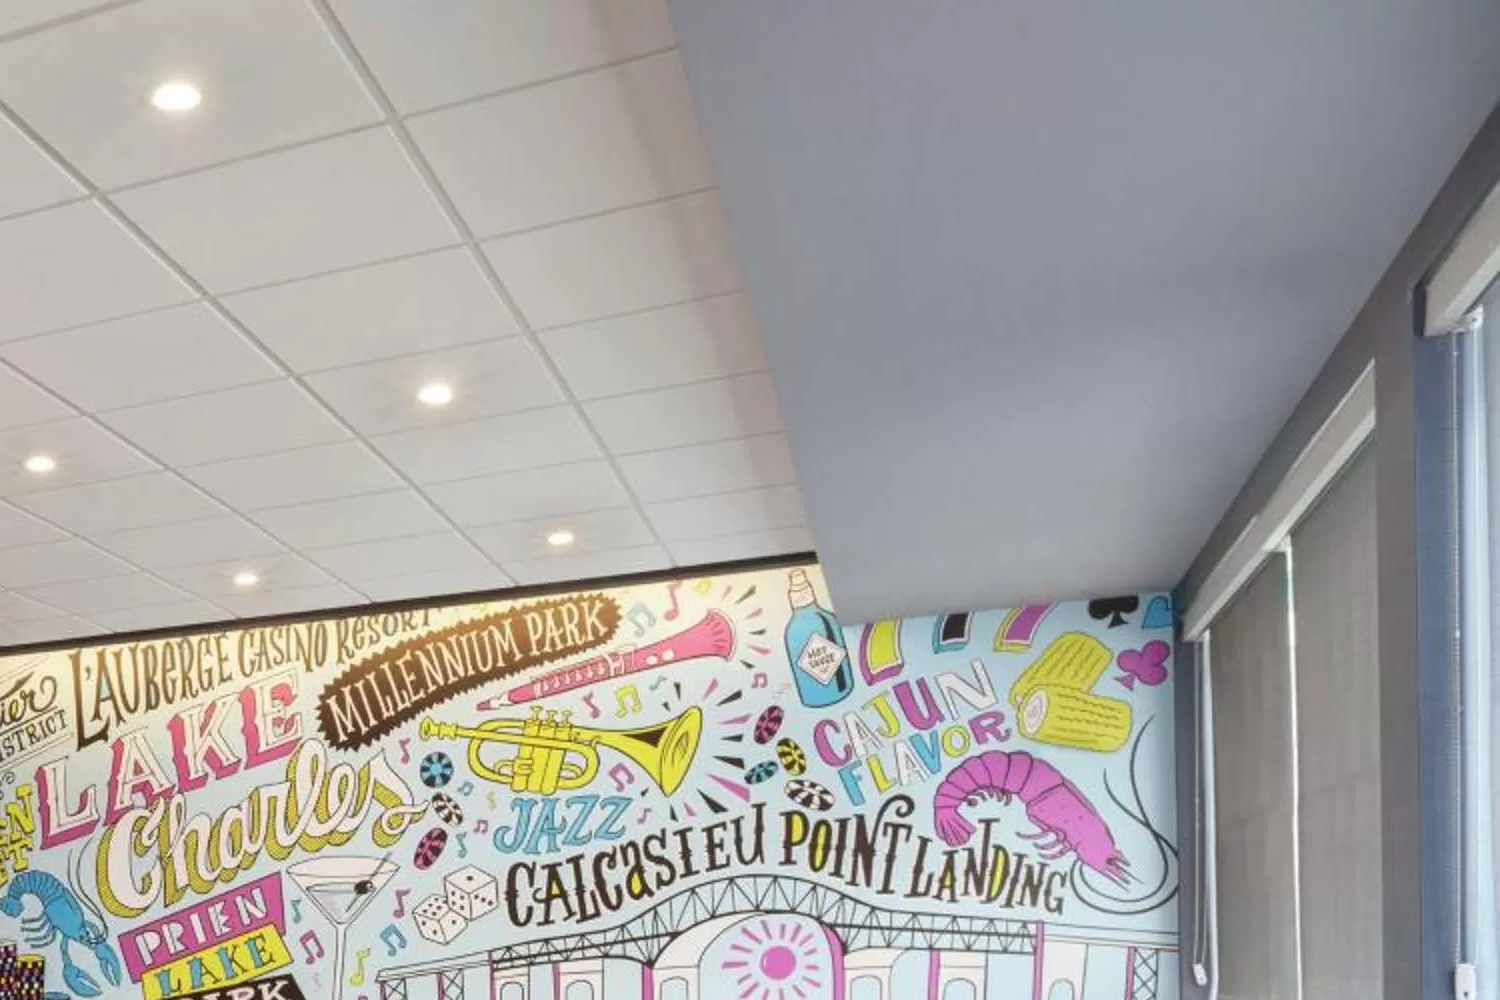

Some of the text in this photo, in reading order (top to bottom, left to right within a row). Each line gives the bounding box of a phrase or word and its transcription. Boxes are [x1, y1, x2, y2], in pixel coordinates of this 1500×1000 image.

[237, 621, 328, 673] CASINO
[326, 600, 609, 742] MILLENNIUM PARK
[36, 672, 303, 850] LAKE
[813, 658, 998, 767] CAJUN
[837, 711, 1012, 806] FLAVOR
[95, 738, 430, 918] Charles
[492, 796, 633, 855] JAZZ
[780, 794, 915, 894] POINT
[904, 818, 1068, 915] LANDING
[135, 887, 268, 967] PRIEN
[154, 932, 275, 997] LAKE
